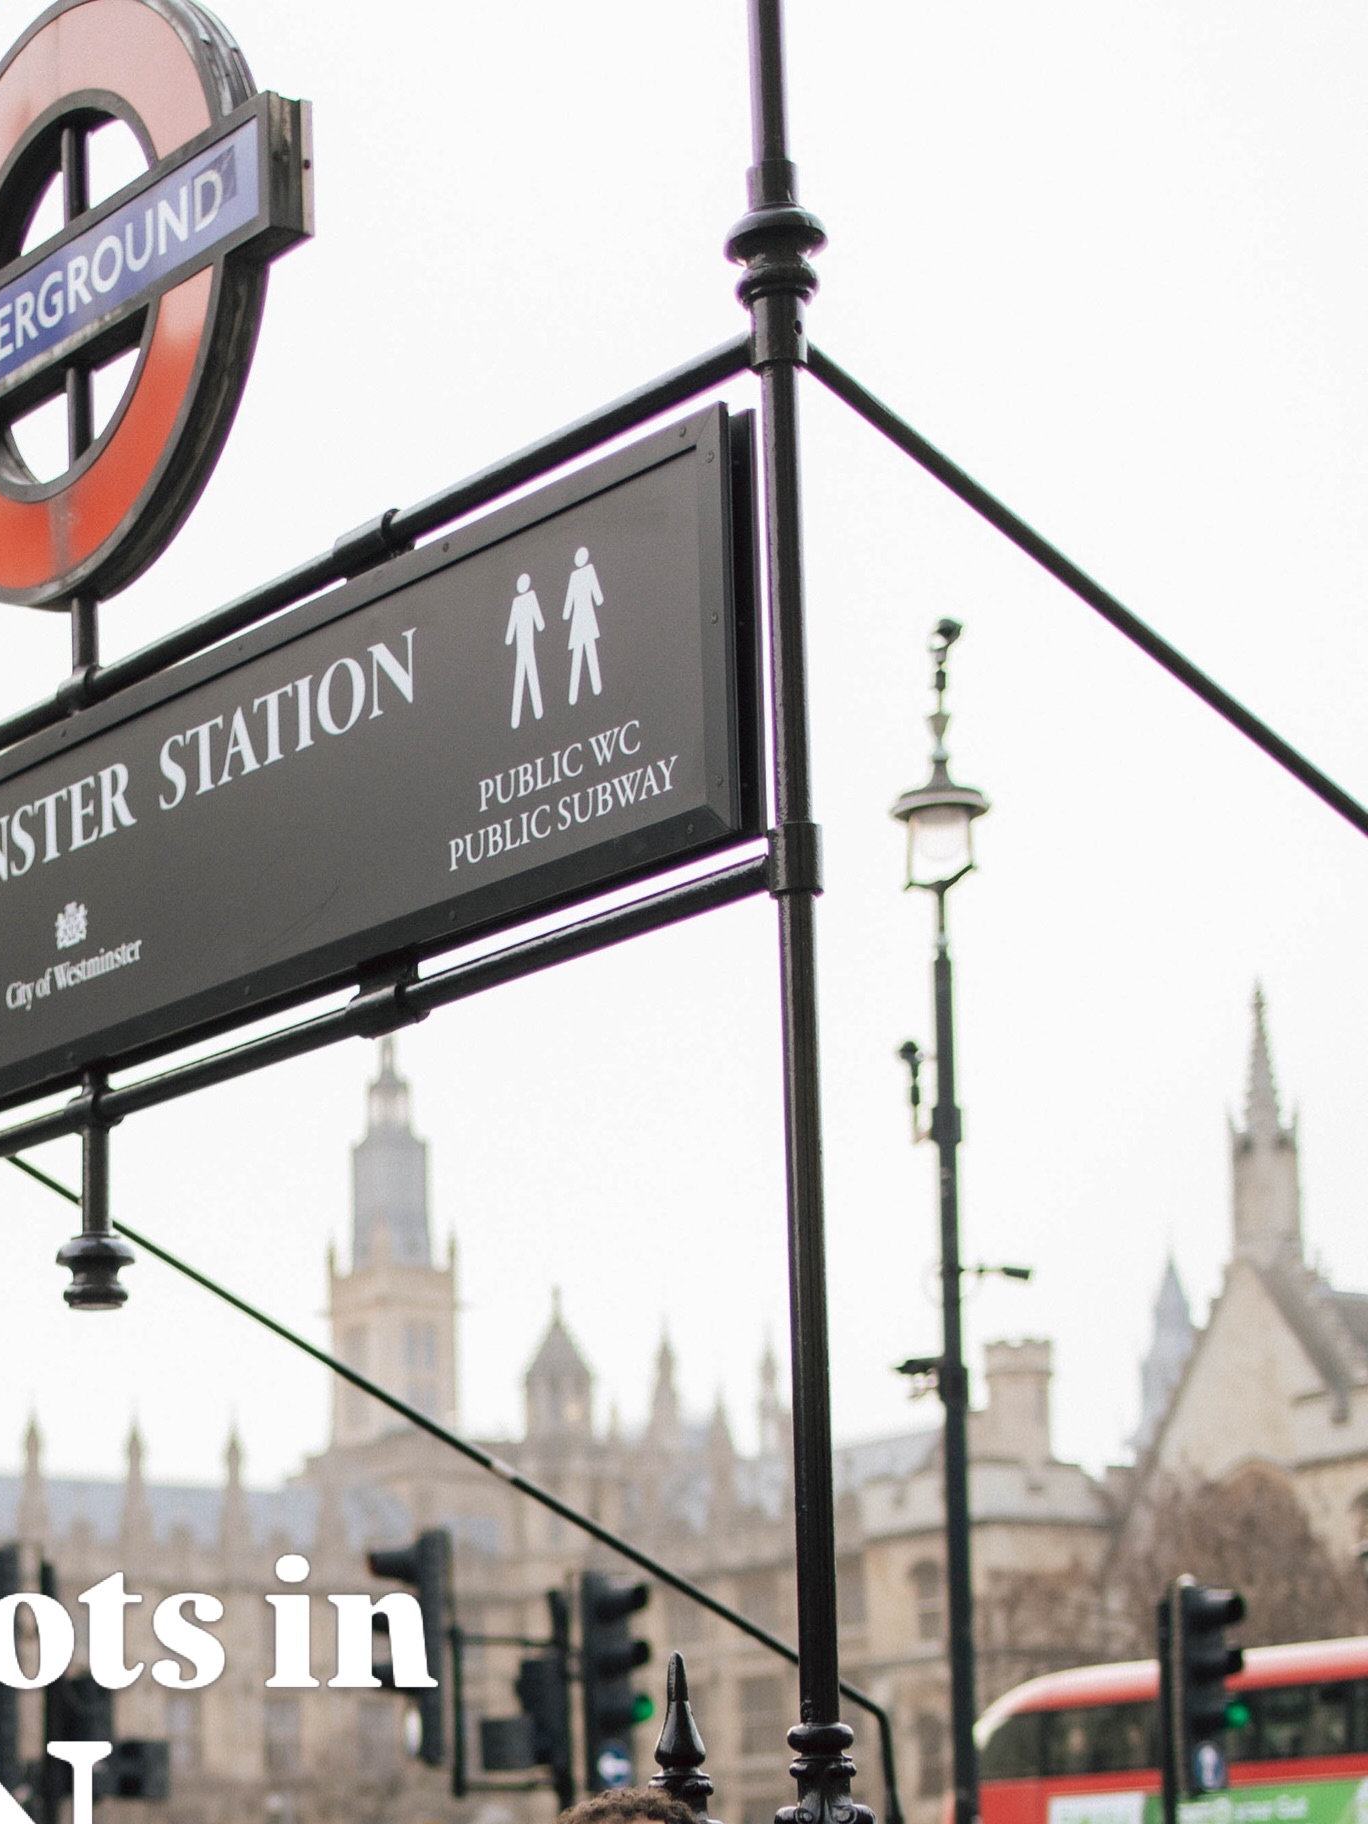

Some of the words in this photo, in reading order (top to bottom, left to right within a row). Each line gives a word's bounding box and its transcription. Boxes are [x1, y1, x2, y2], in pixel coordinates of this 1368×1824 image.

[158, 627, 418, 812] STATION
[478, 742, 584, 812] PUBLIC
[588, 719, 641, 767] WC
[448, 804, 552, 872] PUBLIC
[557, 754, 679, 831] SUBWAY
[5, 981, 35, 1011] City
[35, 967, 52, 999] of
[53, 939, 143, 991] Westminster
